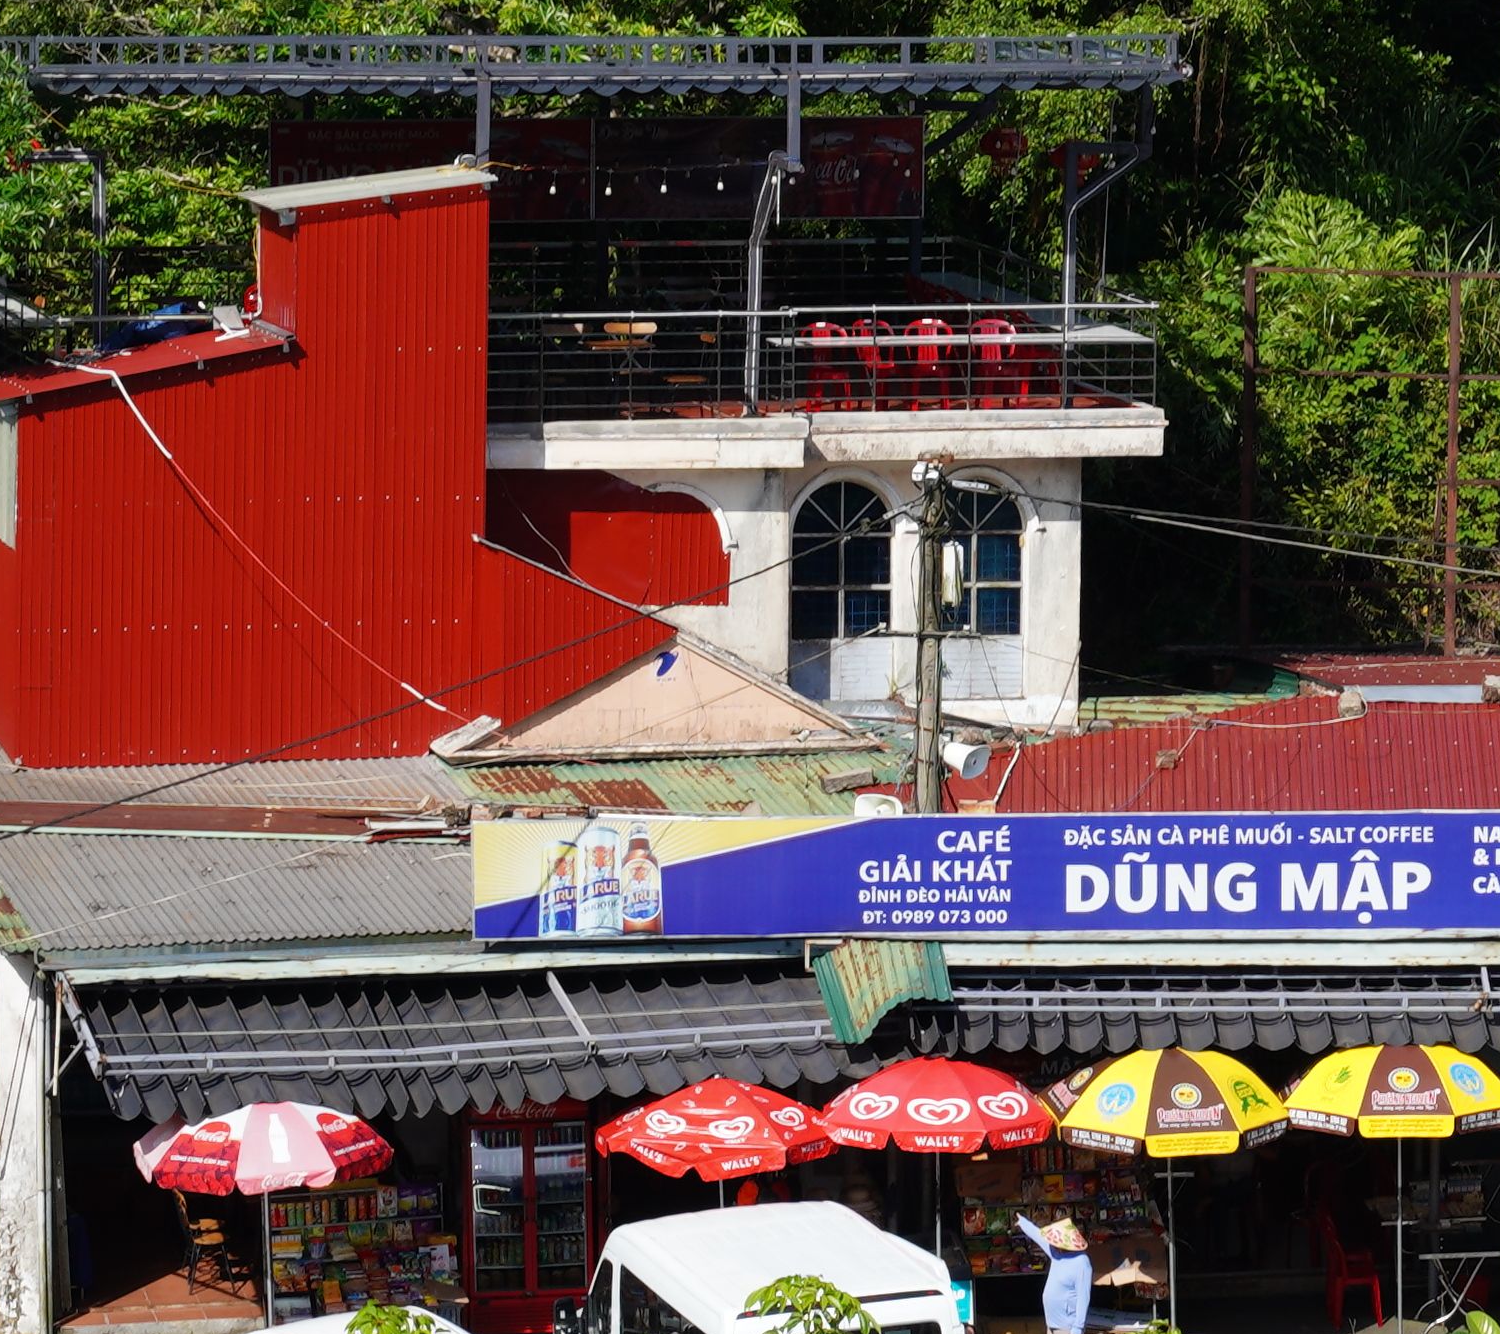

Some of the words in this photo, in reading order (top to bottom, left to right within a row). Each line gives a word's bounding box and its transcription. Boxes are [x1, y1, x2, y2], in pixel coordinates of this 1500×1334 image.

[937, 825, 1011, 853] CAFÉ
[1064, 825, 1105, 849] ĐẶC
[1111, 824, 1150, 846] SẢN
[1157, 824, 1183, 846] CÀ
[1189, 824, 1228, 845] PHÊ
[1235, 822, 1291, 845] MUỐI
[1309, 827, 1355, 845] SALT
[1359, 826, 1433, 844] COFFEE
[1473, 848, 1489, 865] &
[859, 854, 921, 883] GIẢI
[932, 854, 1012, 883] KHÁT
[1066, 852, 1257, 913] DŨNG
[1280, 849, 1432, 925] MẬP
[1473, 873, 1500, 894] CÀ
[582, 879, 619, 904] LARUE
[623, 891, 659, 912] LARUE
[858, 885, 901, 903] ĐỈNH
[906, 886, 940, 903] ĐÈO
[945, 885, 973, 903] HẢI
[977, 885, 1011, 903] VÂN
[863, 910, 886, 924] ĐT:
[891, 910, 934, 924] 0989
[938, 909, 971, 924] 073
[975, 909, 1007, 924] 000
[840, 1127, 874, 1144] WALL'S
[915, 1135, 961, 1148] WALL'S
[1003, 1127, 1036, 1142] WALL'S
[720, 1157, 760, 1173] WALL'S
